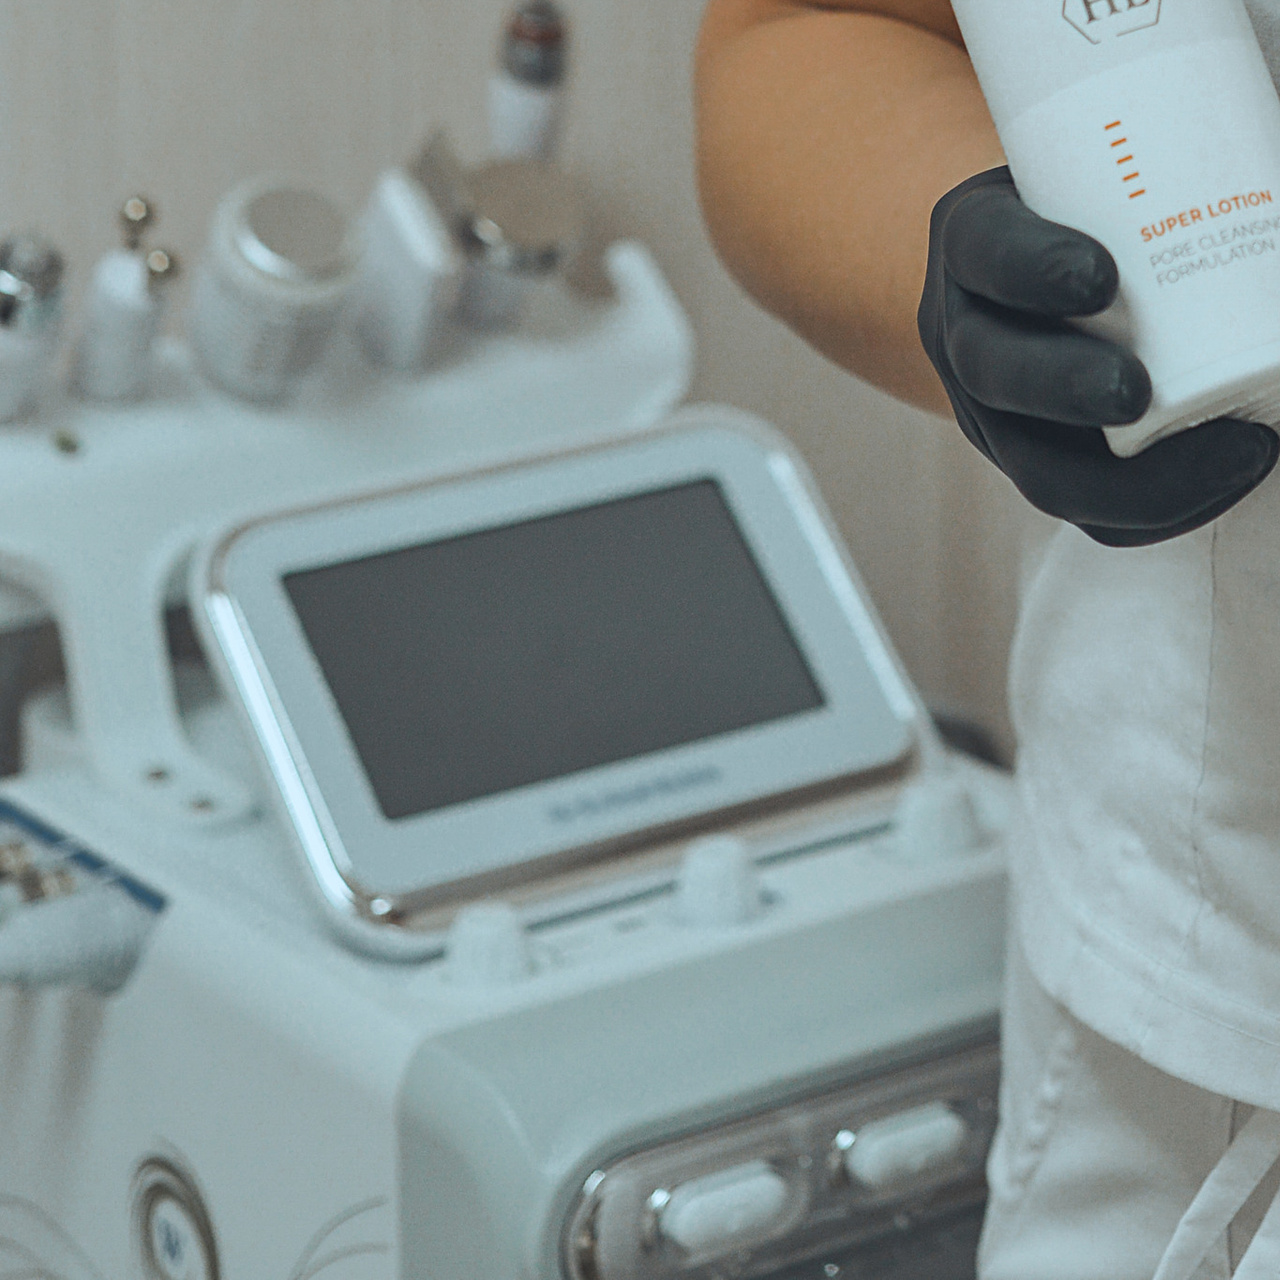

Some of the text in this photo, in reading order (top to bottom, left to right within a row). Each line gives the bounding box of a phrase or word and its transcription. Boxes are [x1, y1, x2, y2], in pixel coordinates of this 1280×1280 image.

[1140, 189, 1273, 243] SUPER LOTION
[1150, 240, 1197, 269] PORE
[1156, 238, 1276, 287] FORMULATION
